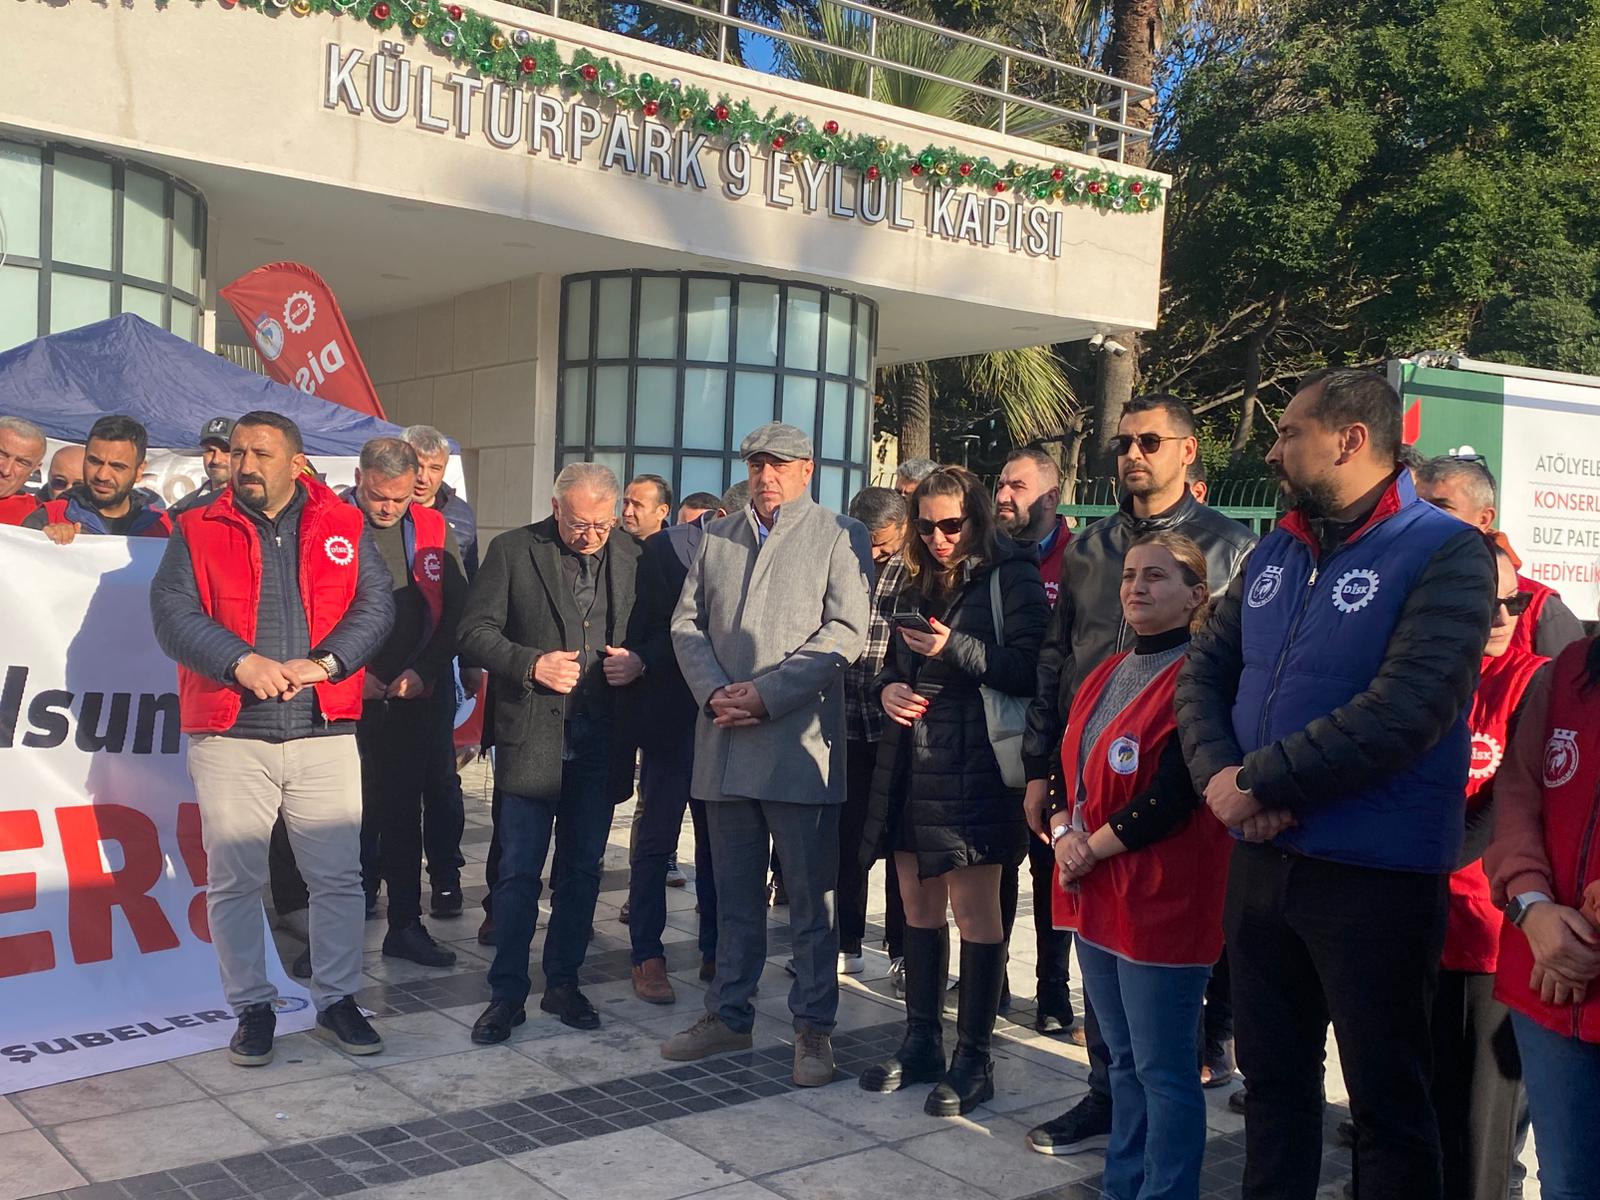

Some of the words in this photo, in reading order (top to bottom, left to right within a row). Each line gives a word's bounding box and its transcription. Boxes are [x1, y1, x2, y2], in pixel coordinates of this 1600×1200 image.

[725, 142, 752, 197] 9
[931, 185, 1063, 259] KAPISI
[1532, 527, 1562, 545] BUZ
[1567, 529, 1600, 547] PATE
